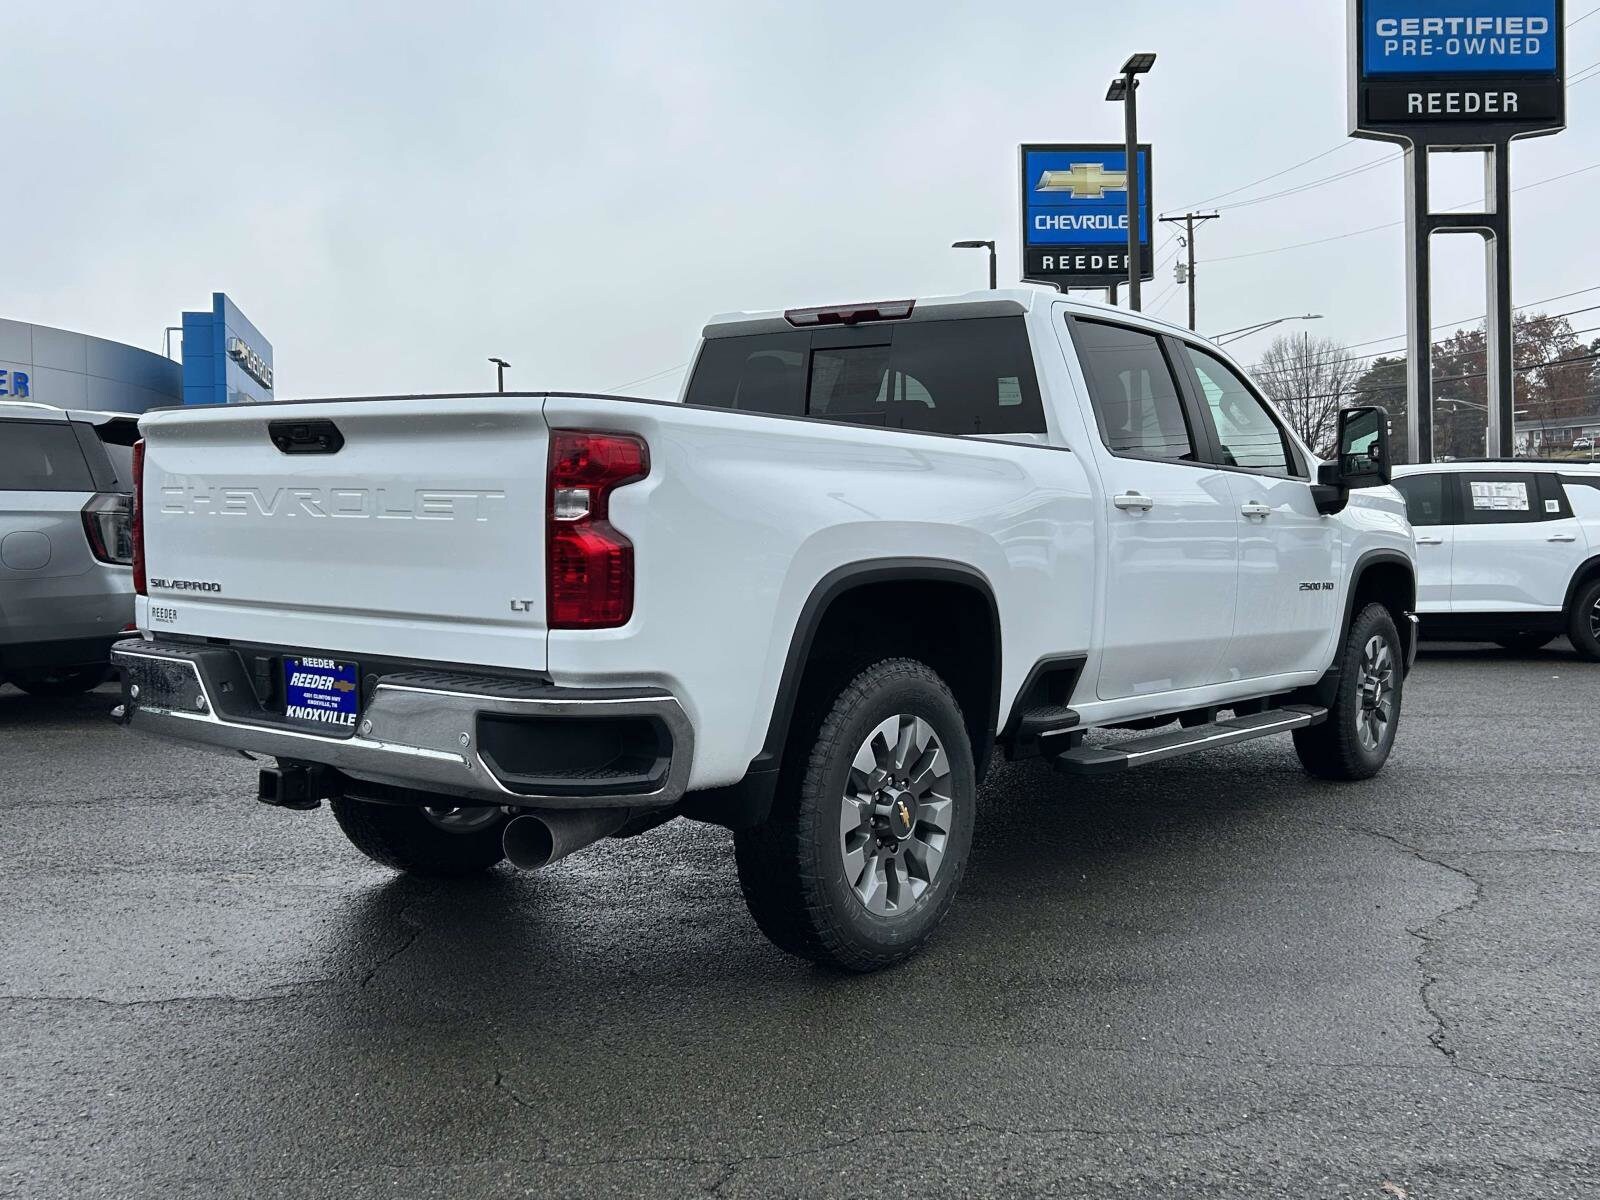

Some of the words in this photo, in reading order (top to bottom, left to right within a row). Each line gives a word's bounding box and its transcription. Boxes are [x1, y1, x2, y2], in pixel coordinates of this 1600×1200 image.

[1376, 17, 1548, 37] CERTIFIED
[1384, 37, 1540, 56] PRE-OWNED
[1407, 92, 1519, 114] REEDER
[1034, 215, 1129, 230] CHEVROLE
[160, 486, 506, 522] CHEVROLET
[150, 578, 222, 592] SILVERADO
[1299, 582, 1321, 591] 2500
[152, 607, 177, 620] REEDER
[510, 599, 534, 612] LT
[302, 657, 335, 669] REEDER
[290, 672, 335, 690] REEDER
[286, 705, 357, 726] KNOXVILLE
